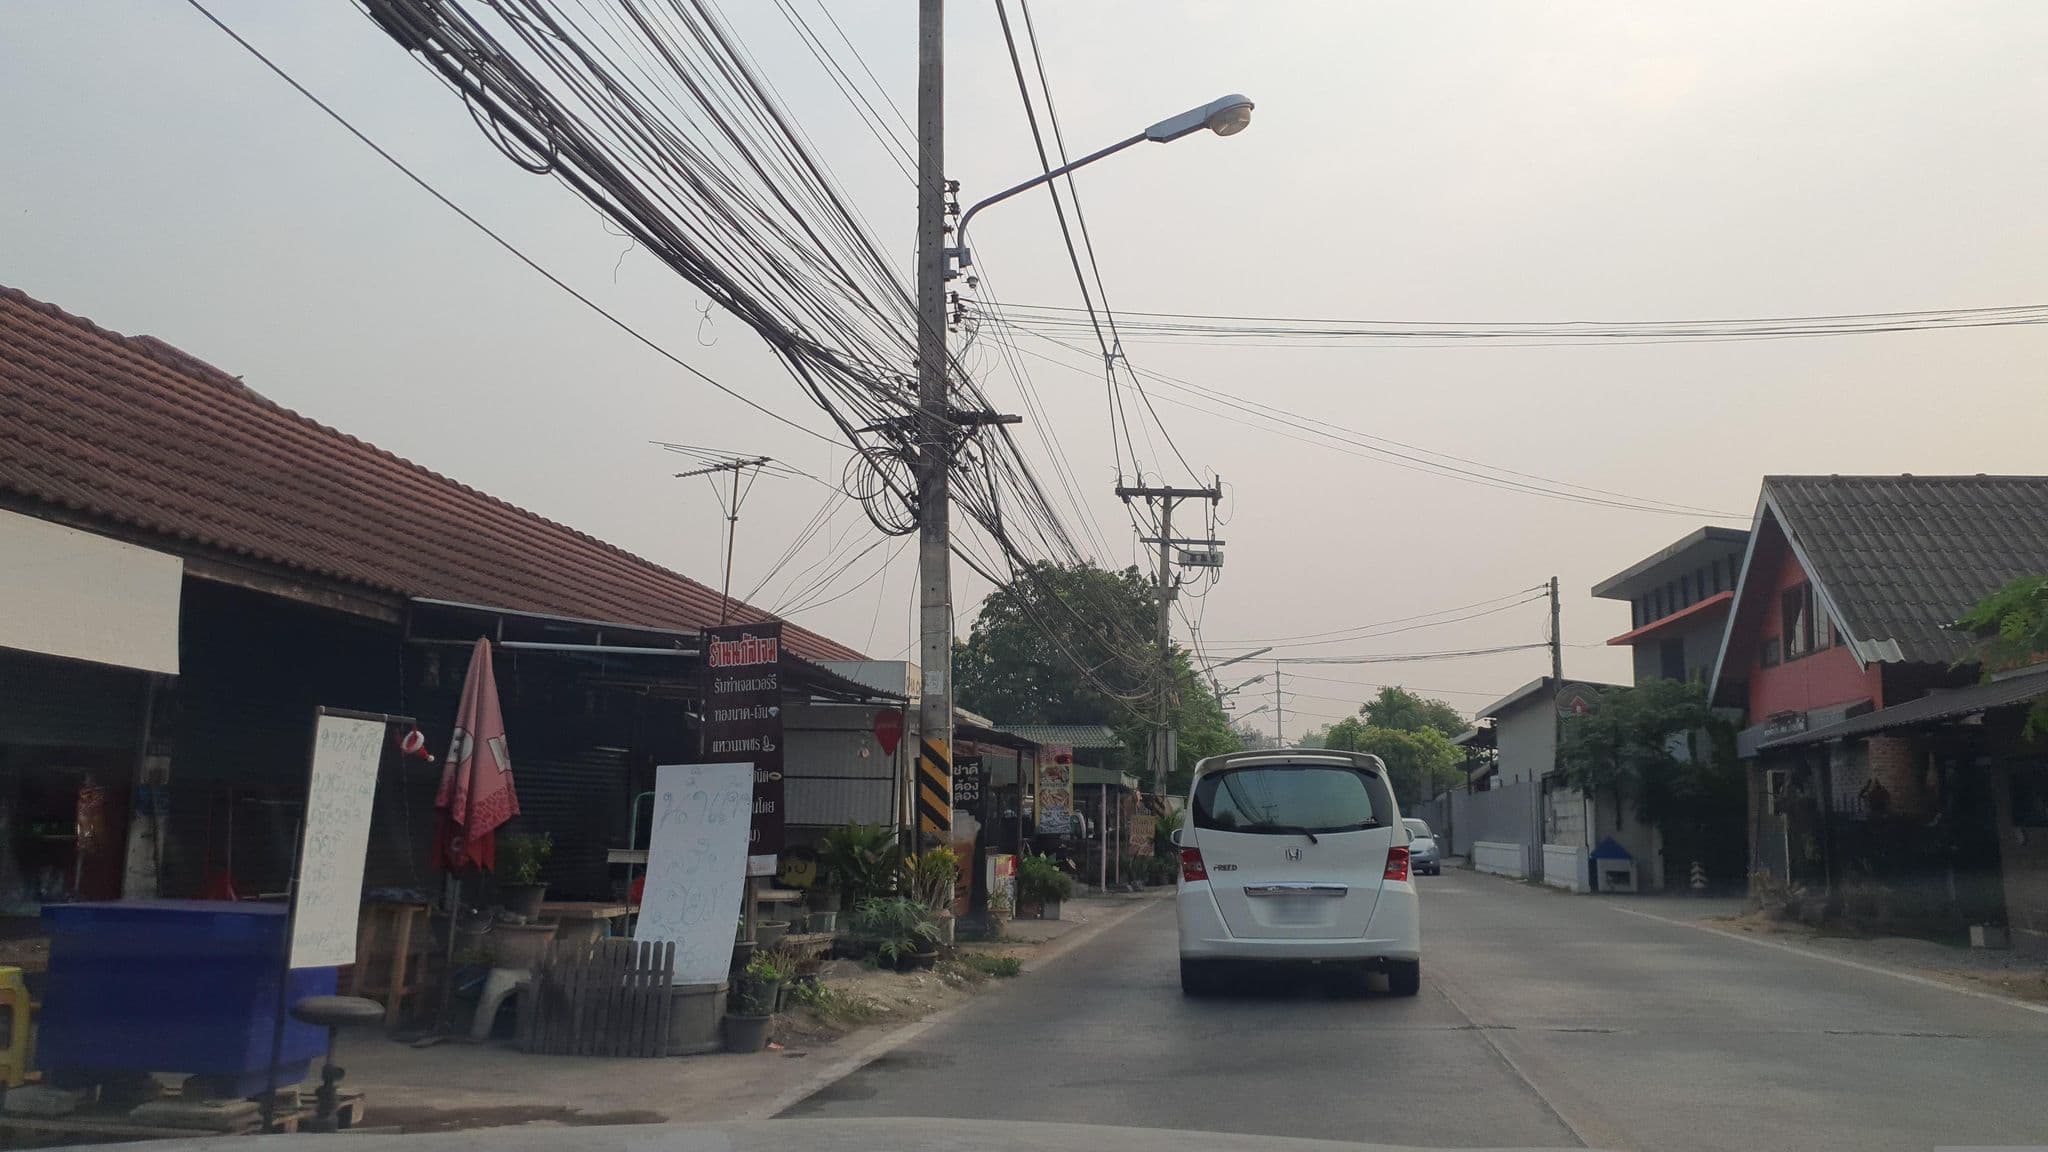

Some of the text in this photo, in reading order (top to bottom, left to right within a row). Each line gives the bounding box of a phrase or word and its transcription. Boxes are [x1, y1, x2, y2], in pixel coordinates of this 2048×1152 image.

[712, 737, 761, 753] แหวนเพชร
[1213, 862, 1238, 872] FREED
